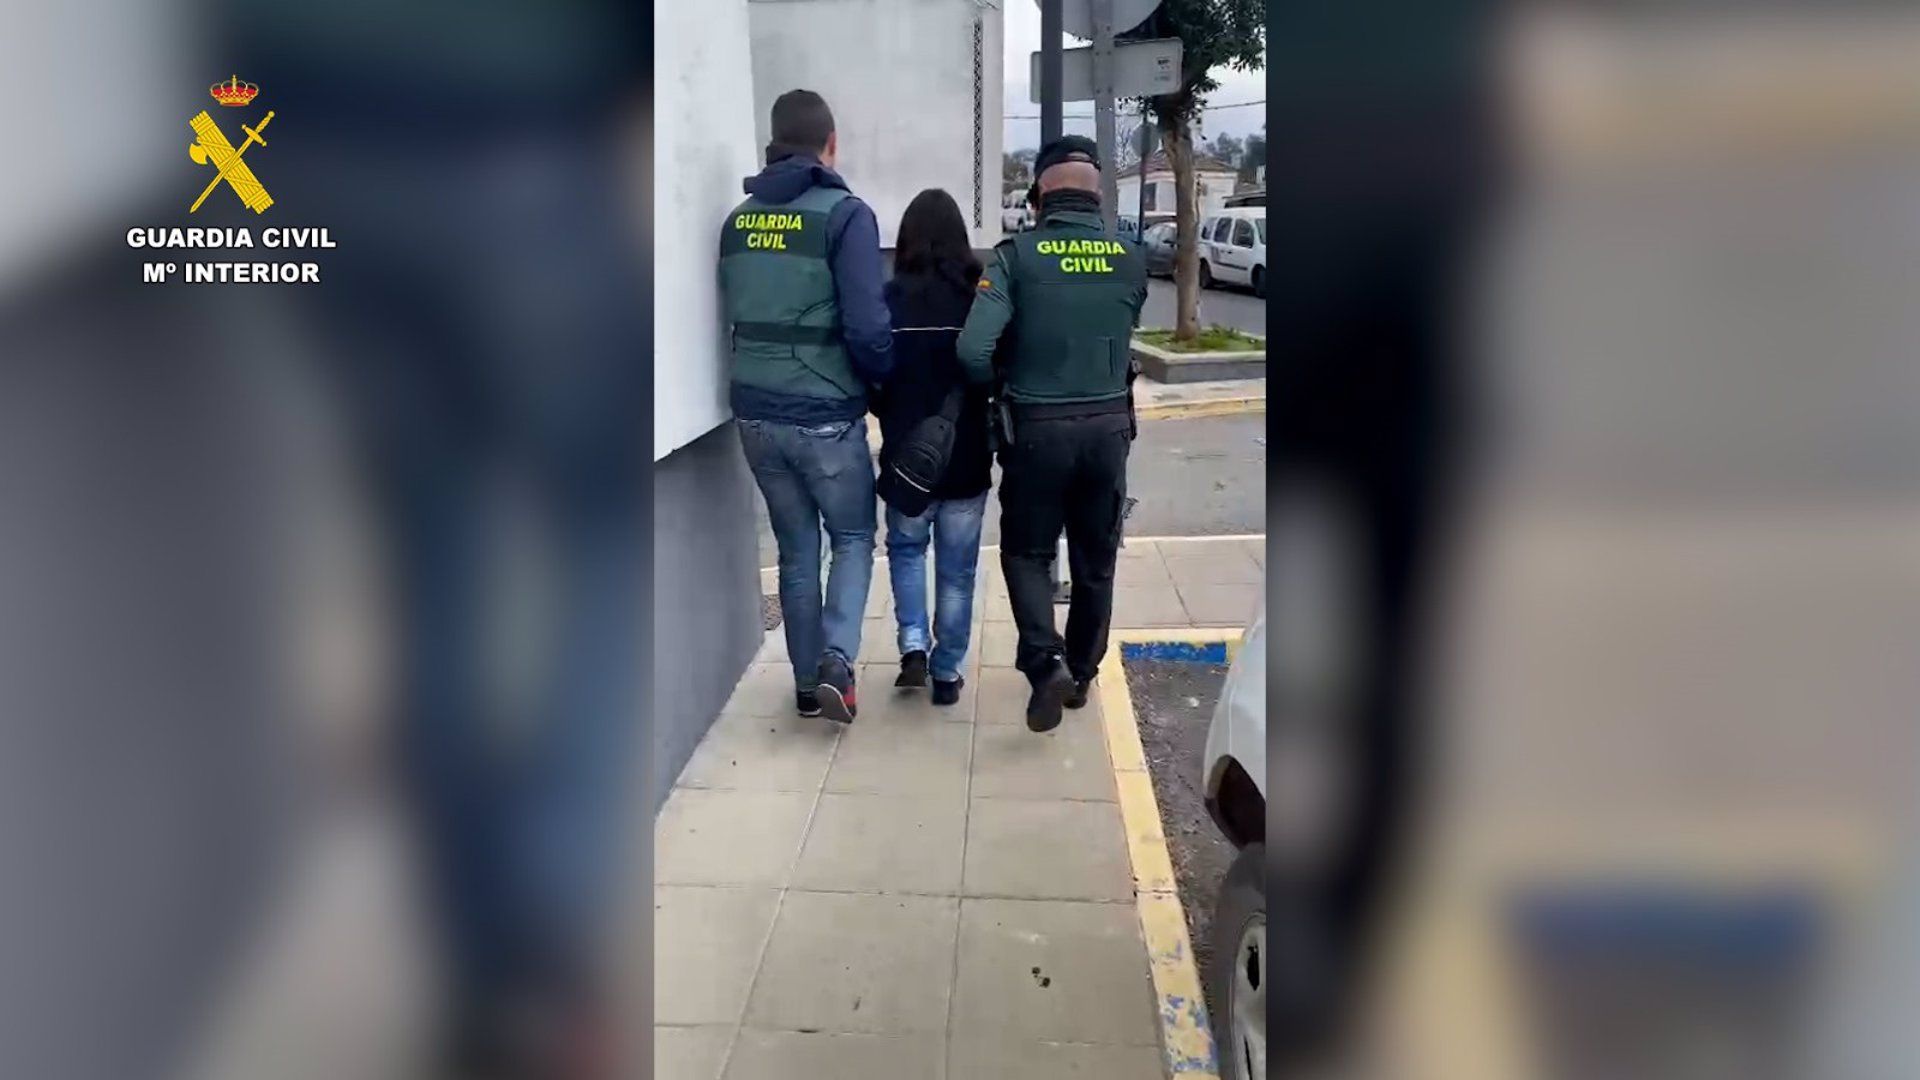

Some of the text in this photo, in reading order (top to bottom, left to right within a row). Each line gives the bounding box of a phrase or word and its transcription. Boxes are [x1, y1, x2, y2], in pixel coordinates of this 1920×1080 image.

[735, 213, 803, 230] GUARDIA
[747, 232, 787, 250] CIVIL
[1036, 240, 1127, 255] GUARDIA
[1060, 256, 1114, 273] CIVIL
